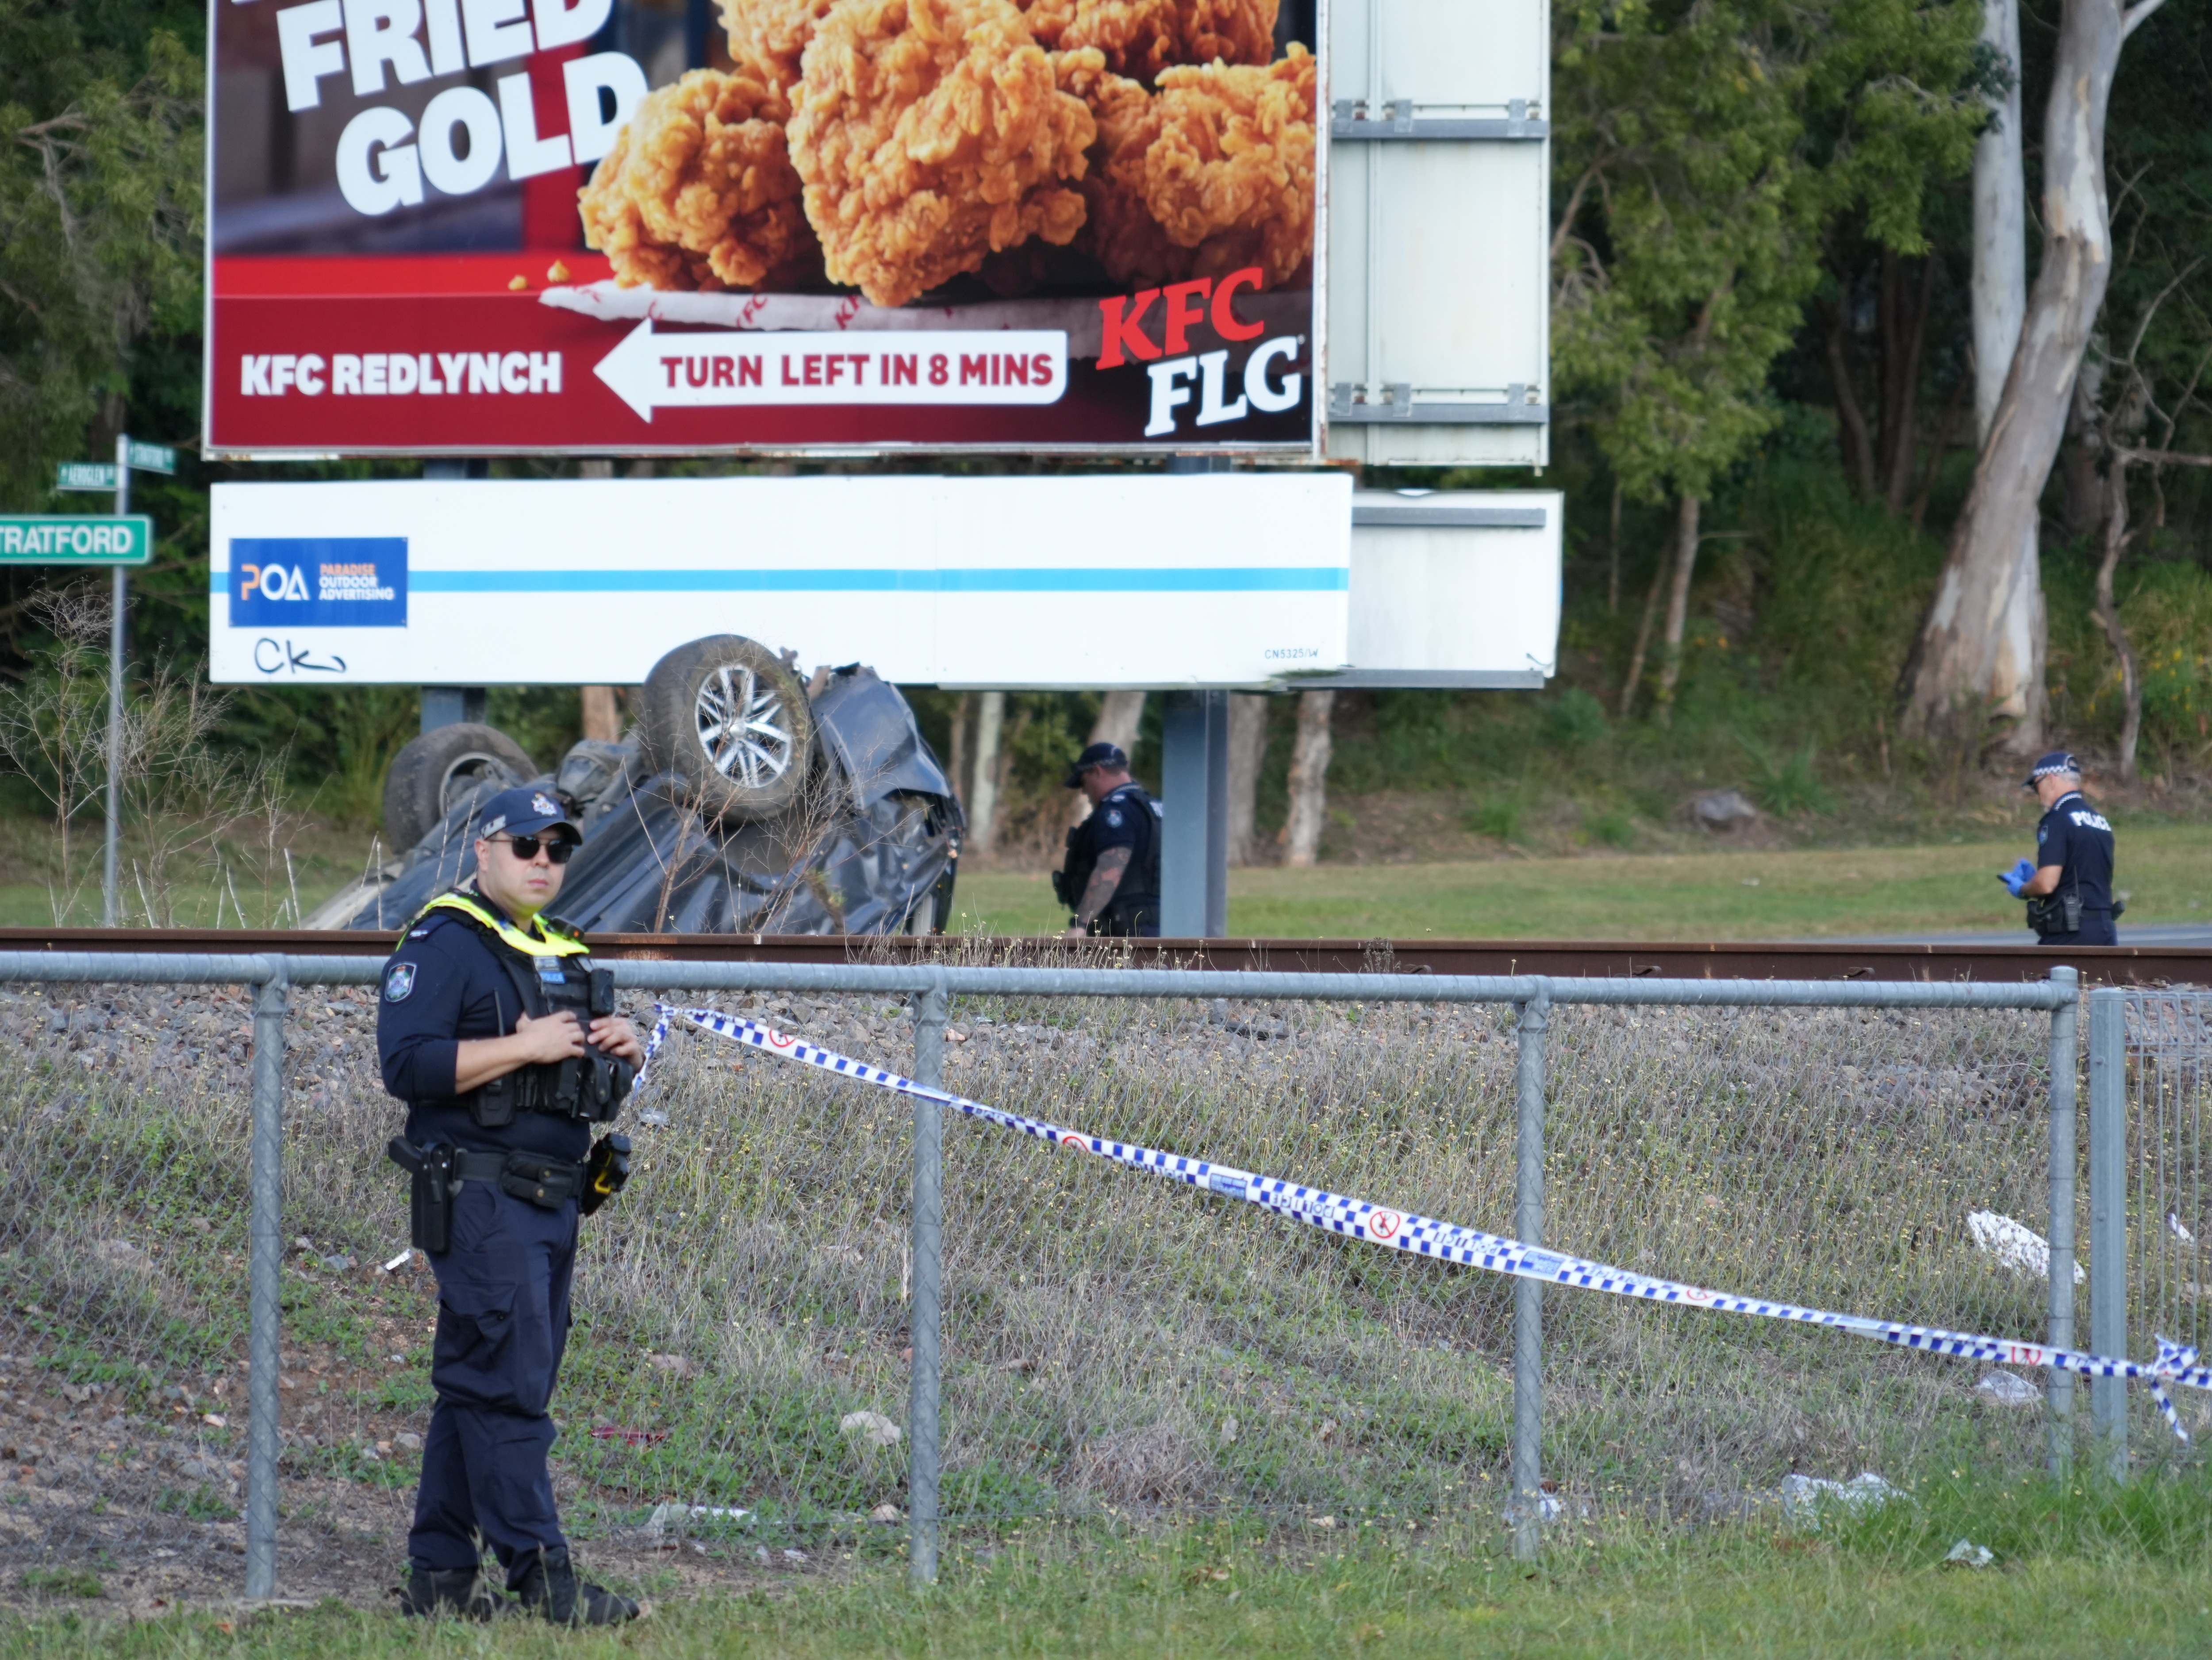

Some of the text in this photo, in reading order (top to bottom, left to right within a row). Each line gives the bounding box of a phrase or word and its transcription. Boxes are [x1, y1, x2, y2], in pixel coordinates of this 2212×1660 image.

[276, 0, 613, 112] FRIED
[336, 52, 648, 216] GOLD
[1096, 267, 1265, 371] KFC
[241, 352, 562, 396] KFC REDLYNCH
[660, 353, 1053, 388] TURN LEFT IN 8 MINS
[1144, 336, 1302, 437] FLG
[0, 525, 133, 555] RATFORD
[241, 563, 310, 601] POA
[319, 576, 378, 588] OUTDOOR
[320, 564, 376, 575] PARADISE
[319, 587, 395, 600] ADVERTISING
[1272, 1193, 1334, 1217] POLICE
